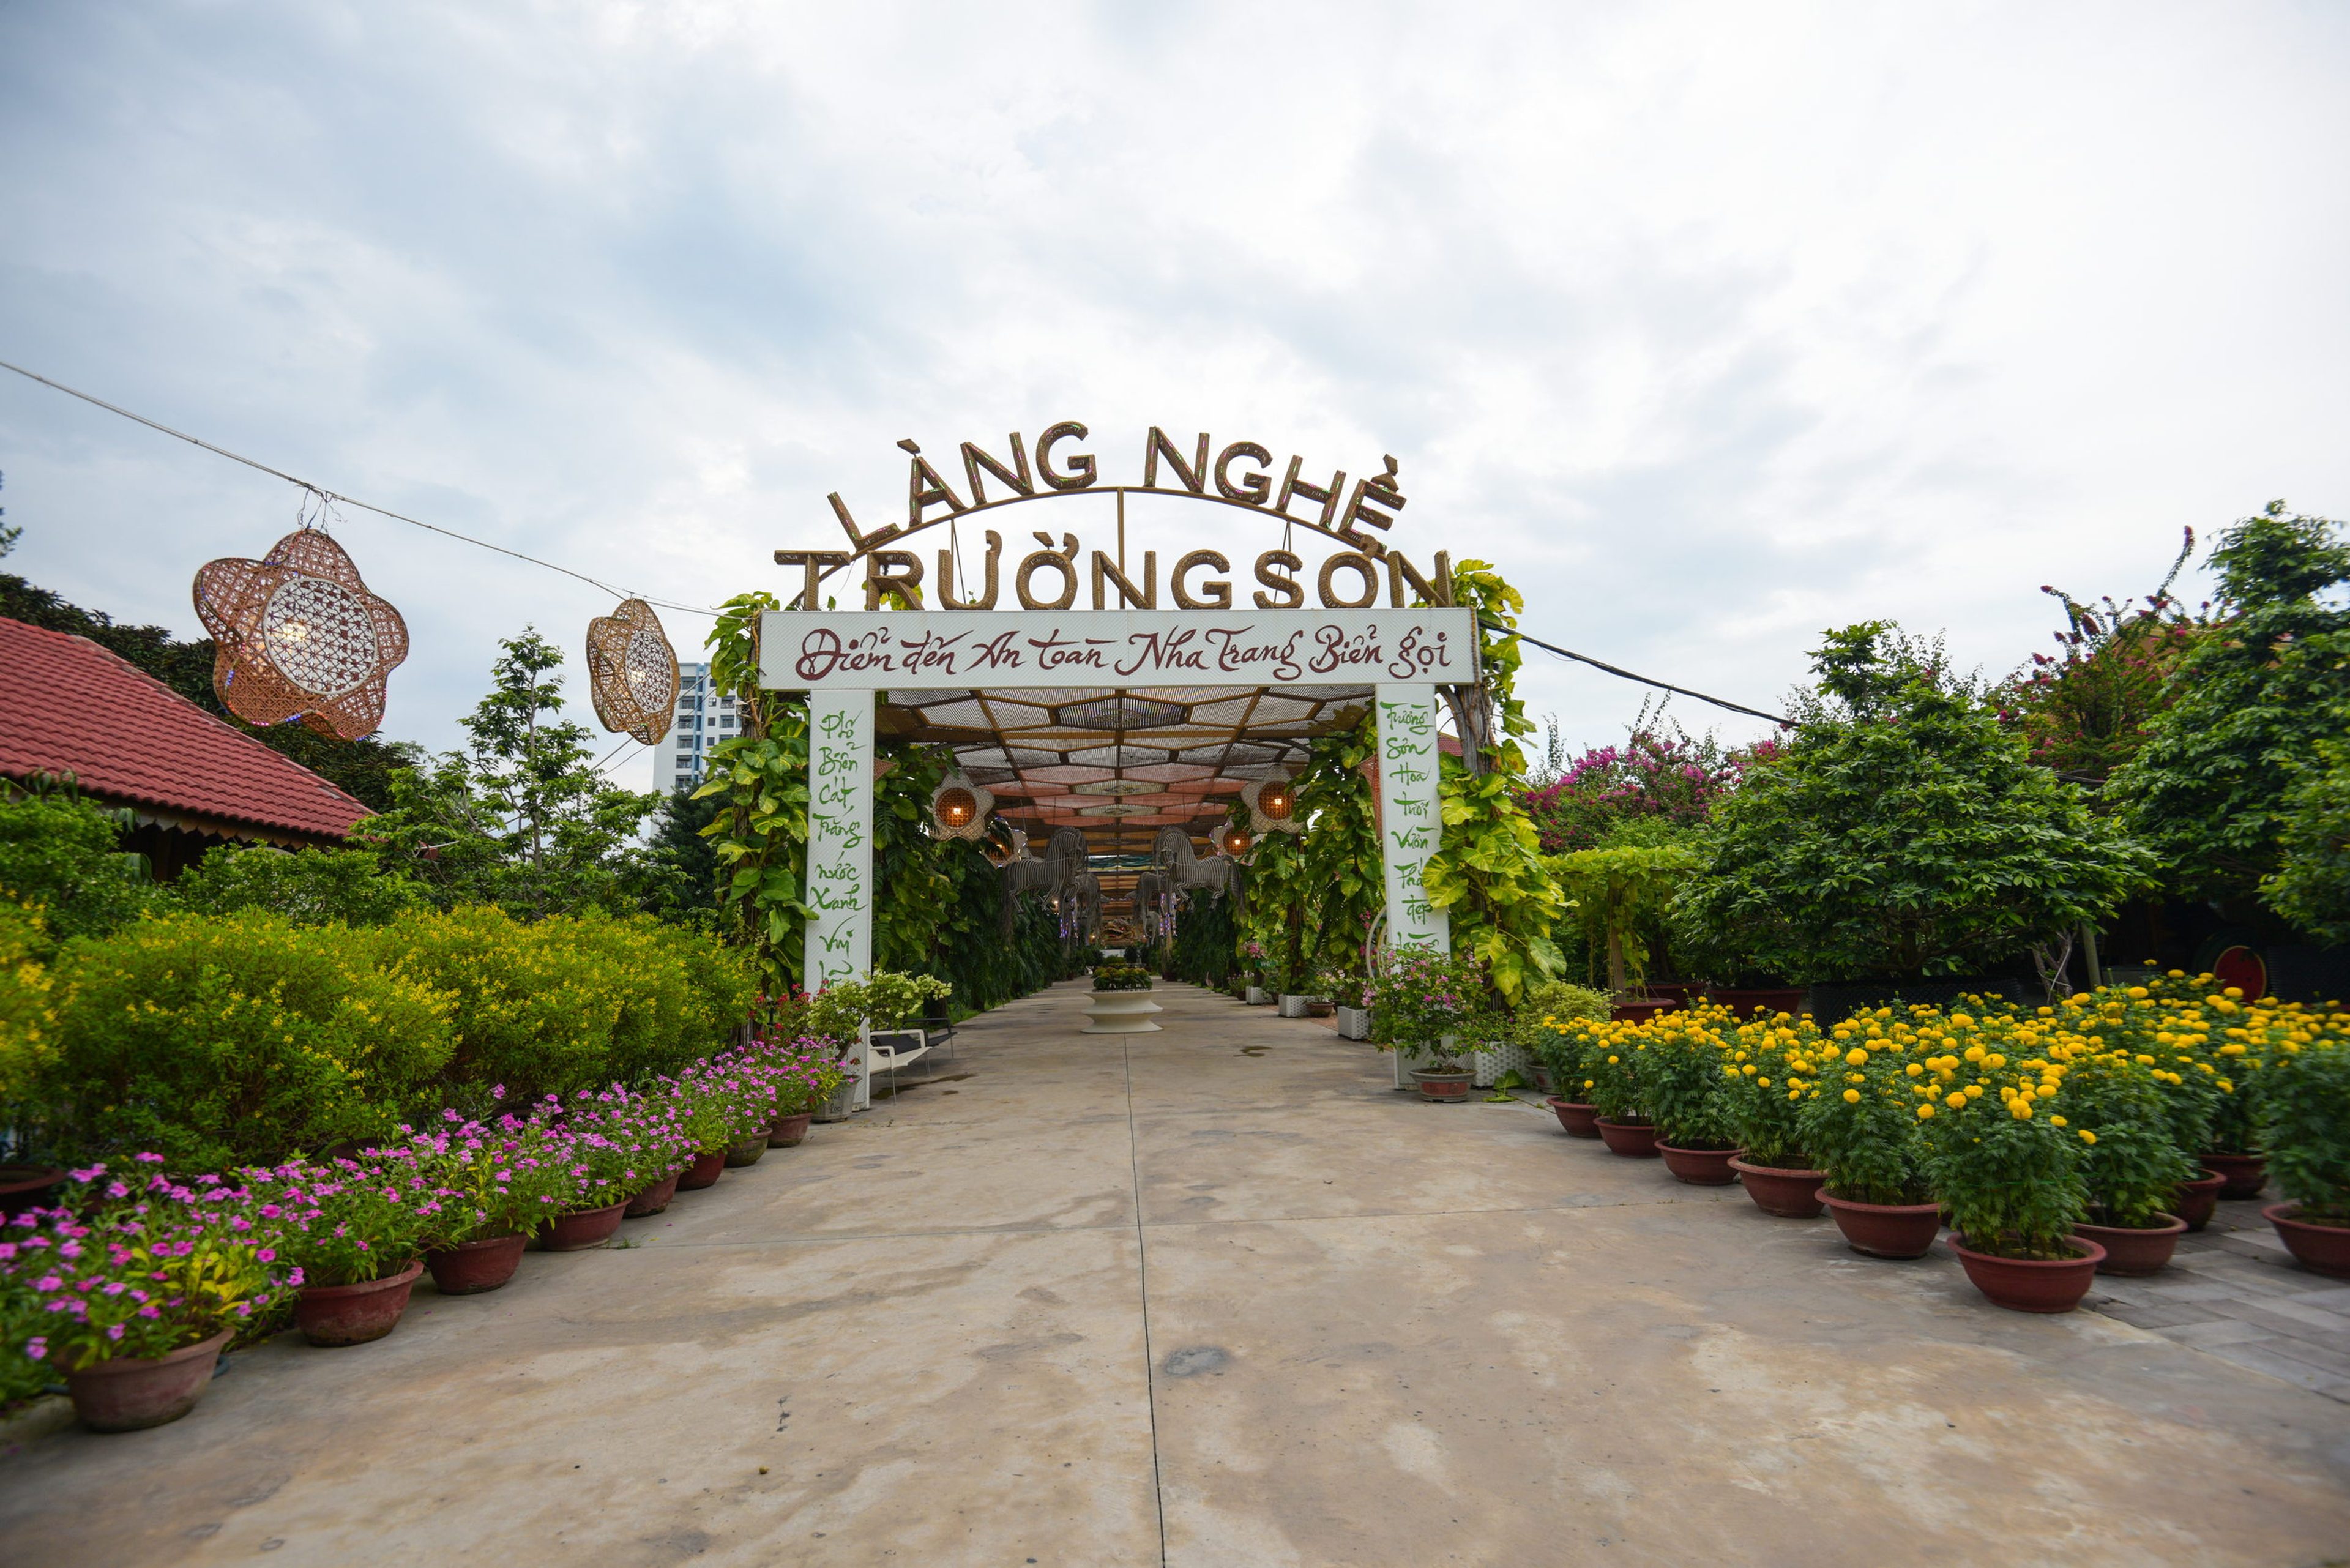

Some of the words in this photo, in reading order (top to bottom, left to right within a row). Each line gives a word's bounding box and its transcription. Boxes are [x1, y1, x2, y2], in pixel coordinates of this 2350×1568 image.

[827, 420, 1097, 550] LÀNG
[1144, 426, 1407, 555] NGHỀ
[796, 627, 901, 681] Điểm
[901, 629, 974, 675] đến
[964, 630, 1028, 671] An
[1028, 629, 1118, 670] toàn
[1114, 625, 1210, 676] Nha
[1205, 625, 1304, 681] Trang
[1308, 624, 1384, 674] Biển
[1389, 625, 1452, 679] gọi
[819, 709, 863, 739] Phố
[1379, 701, 1435, 735] Trường
[818, 741, 867, 776] Biển
[1386, 737, 1433, 759] Sơn
[1389, 762, 1431, 786] Hoa
[819, 776, 859, 808] Cát
[812, 805, 866, 848] Trắng
[1390, 824, 1438, 849] Vườn
[810, 883, 870, 911] Xanh
[1402, 894, 1433, 925] đẹp
